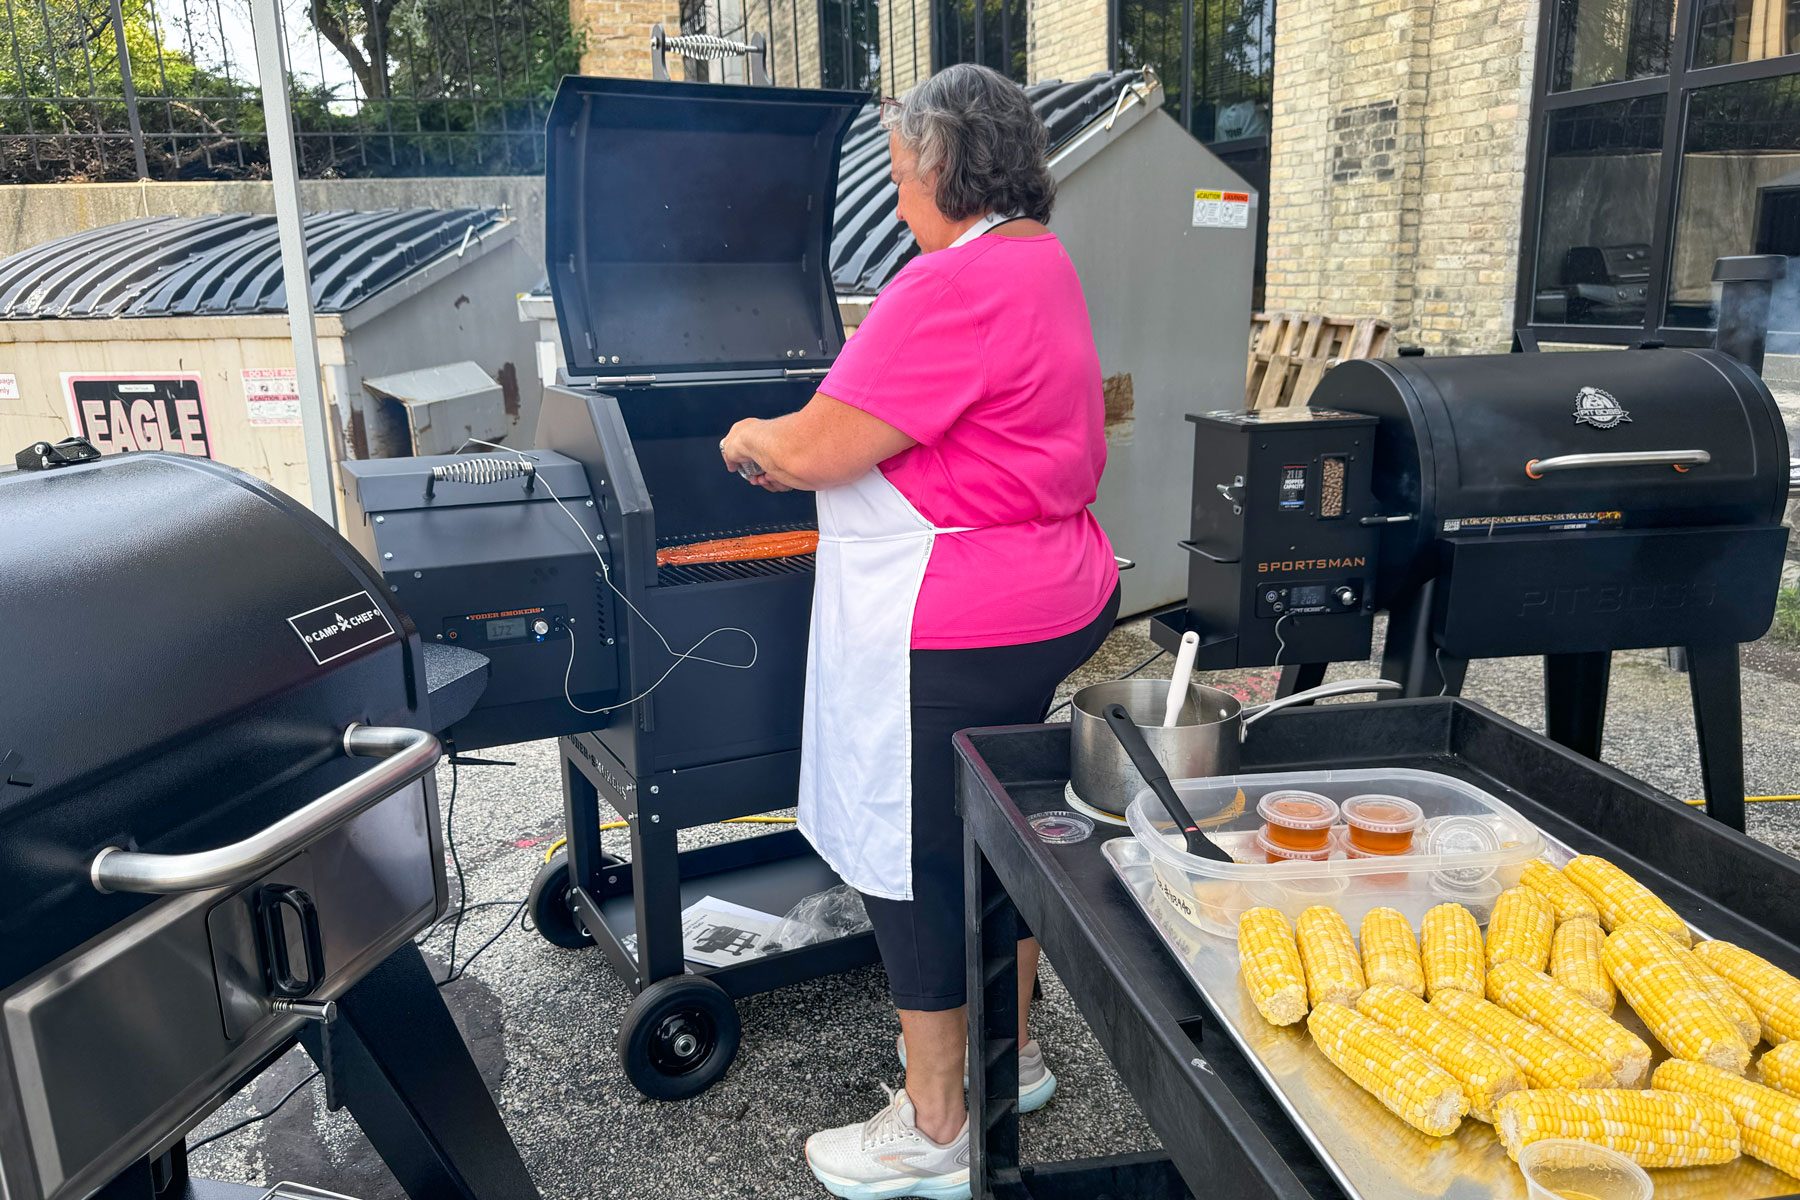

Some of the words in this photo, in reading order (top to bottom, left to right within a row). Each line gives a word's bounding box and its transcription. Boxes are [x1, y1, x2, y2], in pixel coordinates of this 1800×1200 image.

[1199, 191, 1221, 199] CAUTION
[1594, 408, 1621, 416] BOSS
[82, 399, 207, 456] EAGLE
[1257, 556, 1365, 573] SPORTSMAN
[469, 612, 500, 621] YODER
[500, 607, 541, 618] SMOKERS
[312, 624, 339, 641] CAMP
[349, 610, 374, 626] CHEF
